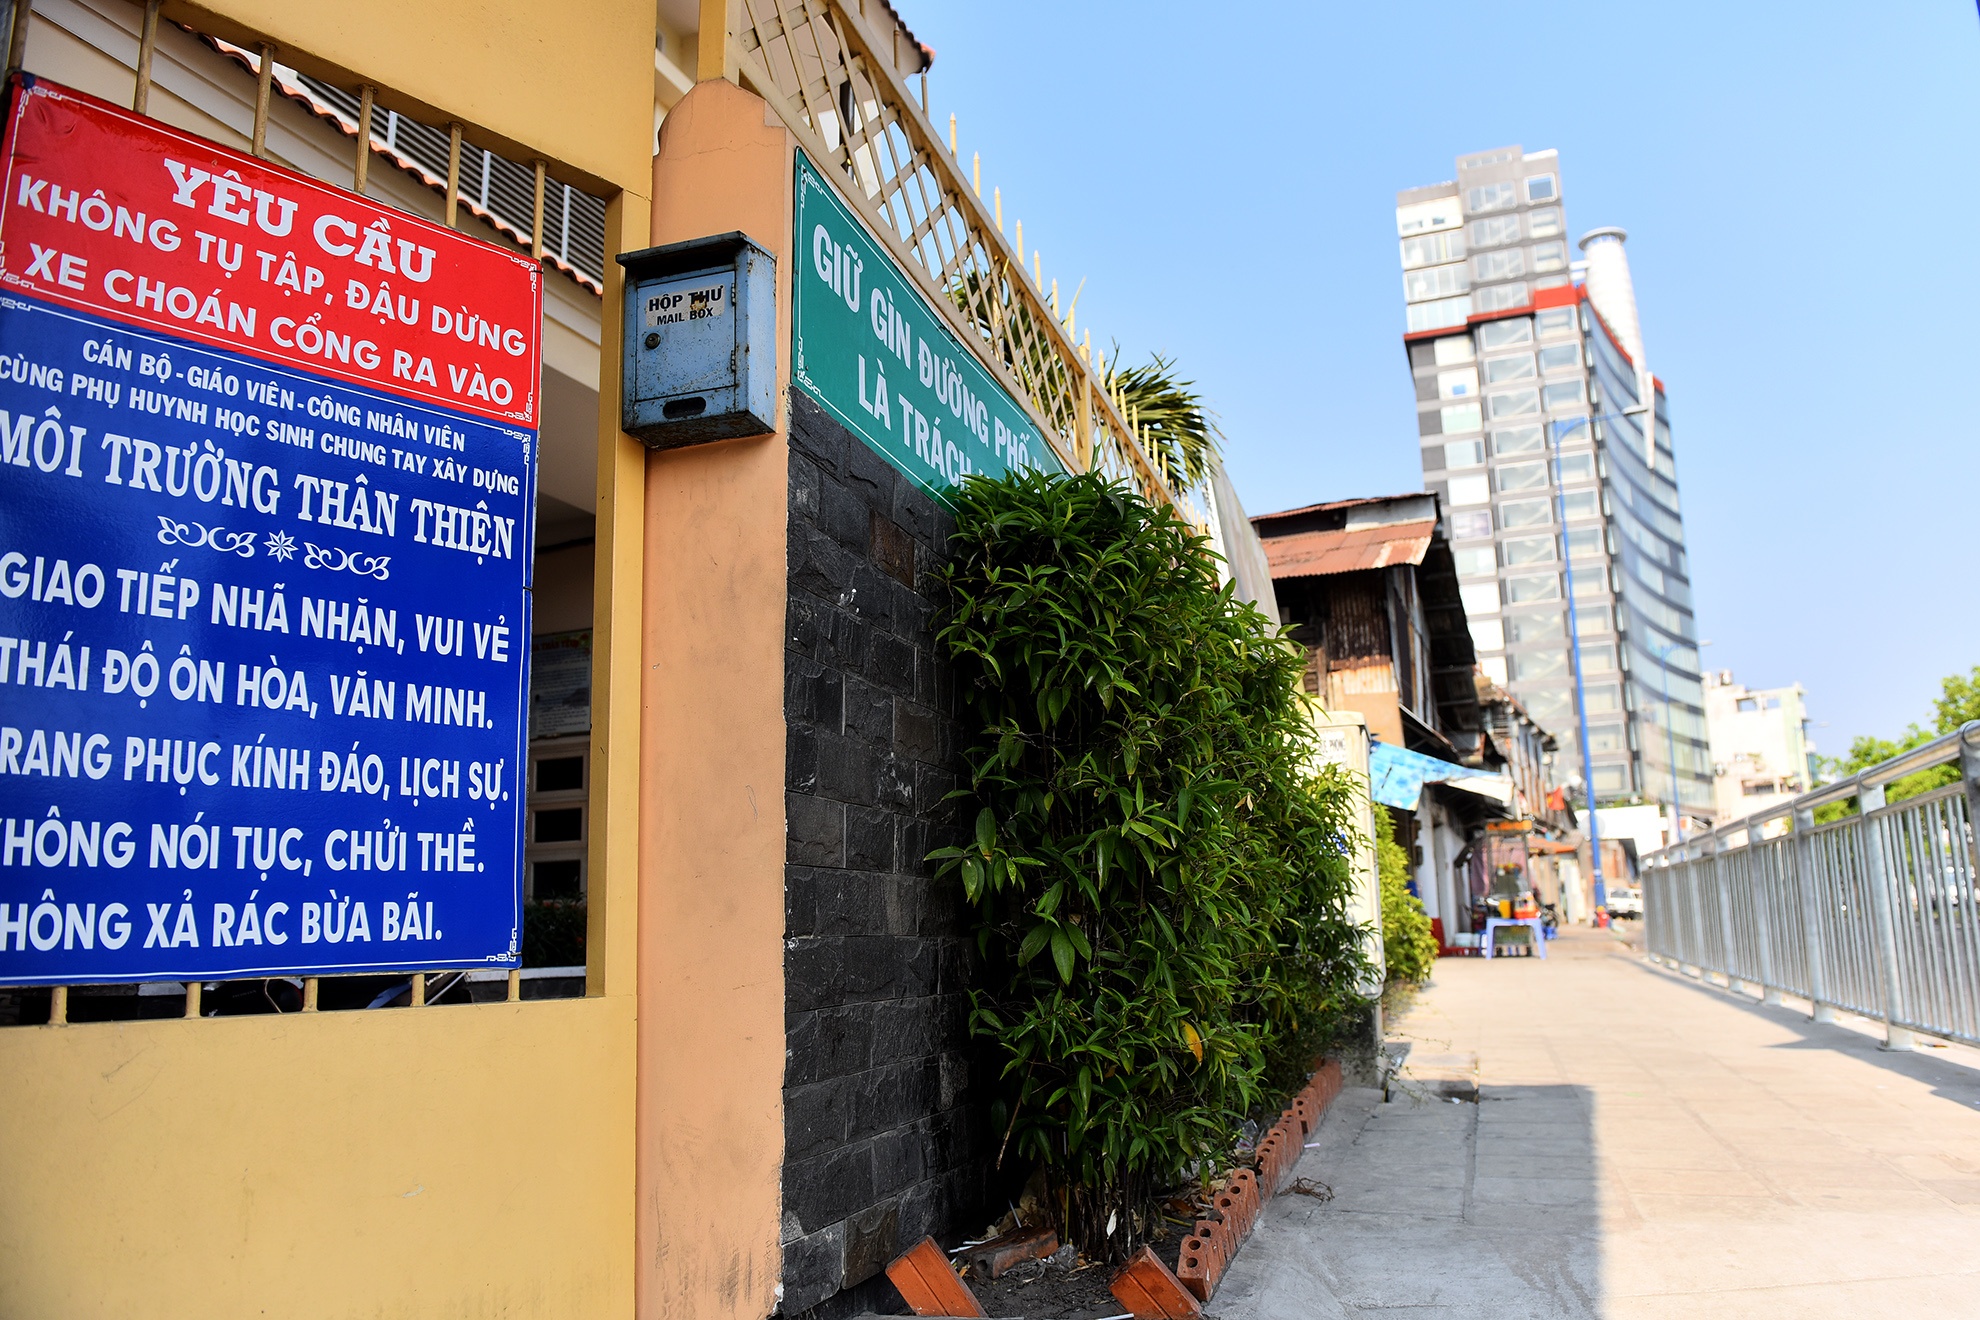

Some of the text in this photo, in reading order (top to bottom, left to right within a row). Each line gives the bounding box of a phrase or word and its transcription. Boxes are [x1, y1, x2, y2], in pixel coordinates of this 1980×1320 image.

[18, 175, 526, 356] KHÔNG TỤ TẬP, ĐẬU DỪNG
[164, 158, 436, 282] YÊU CẦU
[25, 243, 512, 405] XE CHOÁN CỔNG RA VÀO
[649, 285, 724, 312] HỘP THƯ
[657, 307, 713, 325] MAIL BOX
[813, 224, 1030, 480] GIỮ GÌN ĐƯỜNG PHỐ
[0, 354, 518, 495] CÙNG PHỤ HUYNH HỌC SINH CHUNG TAY XÂY DỰNG
[83, 339, 132, 370] CÁN
[139, 353, 171, 384] BỘ
[367, 410, 418, 440] NHÂN
[424, 425, 465, 451] VIÊN
[858, 354, 972, 490] LÀ TRÁCH
[0, 405, 514, 565] MÔI TRƯỜNG THÂN THIỆN
[0, 551, 509, 662] GIAO TIẾP NHÃ NHẶN, VUI VẺ
[0, 630, 89, 691] THÁI
[102, 639, 159, 708] ĐỘ
[169, 645, 224, 703] ÔN
[237, 655, 318, 719] HÒA,
[330, 670, 395, 719] VĂN
[406, 683, 492, 730] MINH.
[124, 736, 221, 796] PHỤC
[232, 734, 310, 790] KÍNH
[319, 741, 390, 801] ĐÁO,
[400, 757, 459, 807] LỊCH
[469, 758, 508, 810] SỰ.
[0, 806, 484, 881] HÔNG NÓI TỤC, CHỬI THỀ.
[143, 889, 199, 948] XẢ
[213, 889, 289, 945] RÁC
[302, 889, 371, 943] BỪA
[383, 892, 442, 941] BÃI.
